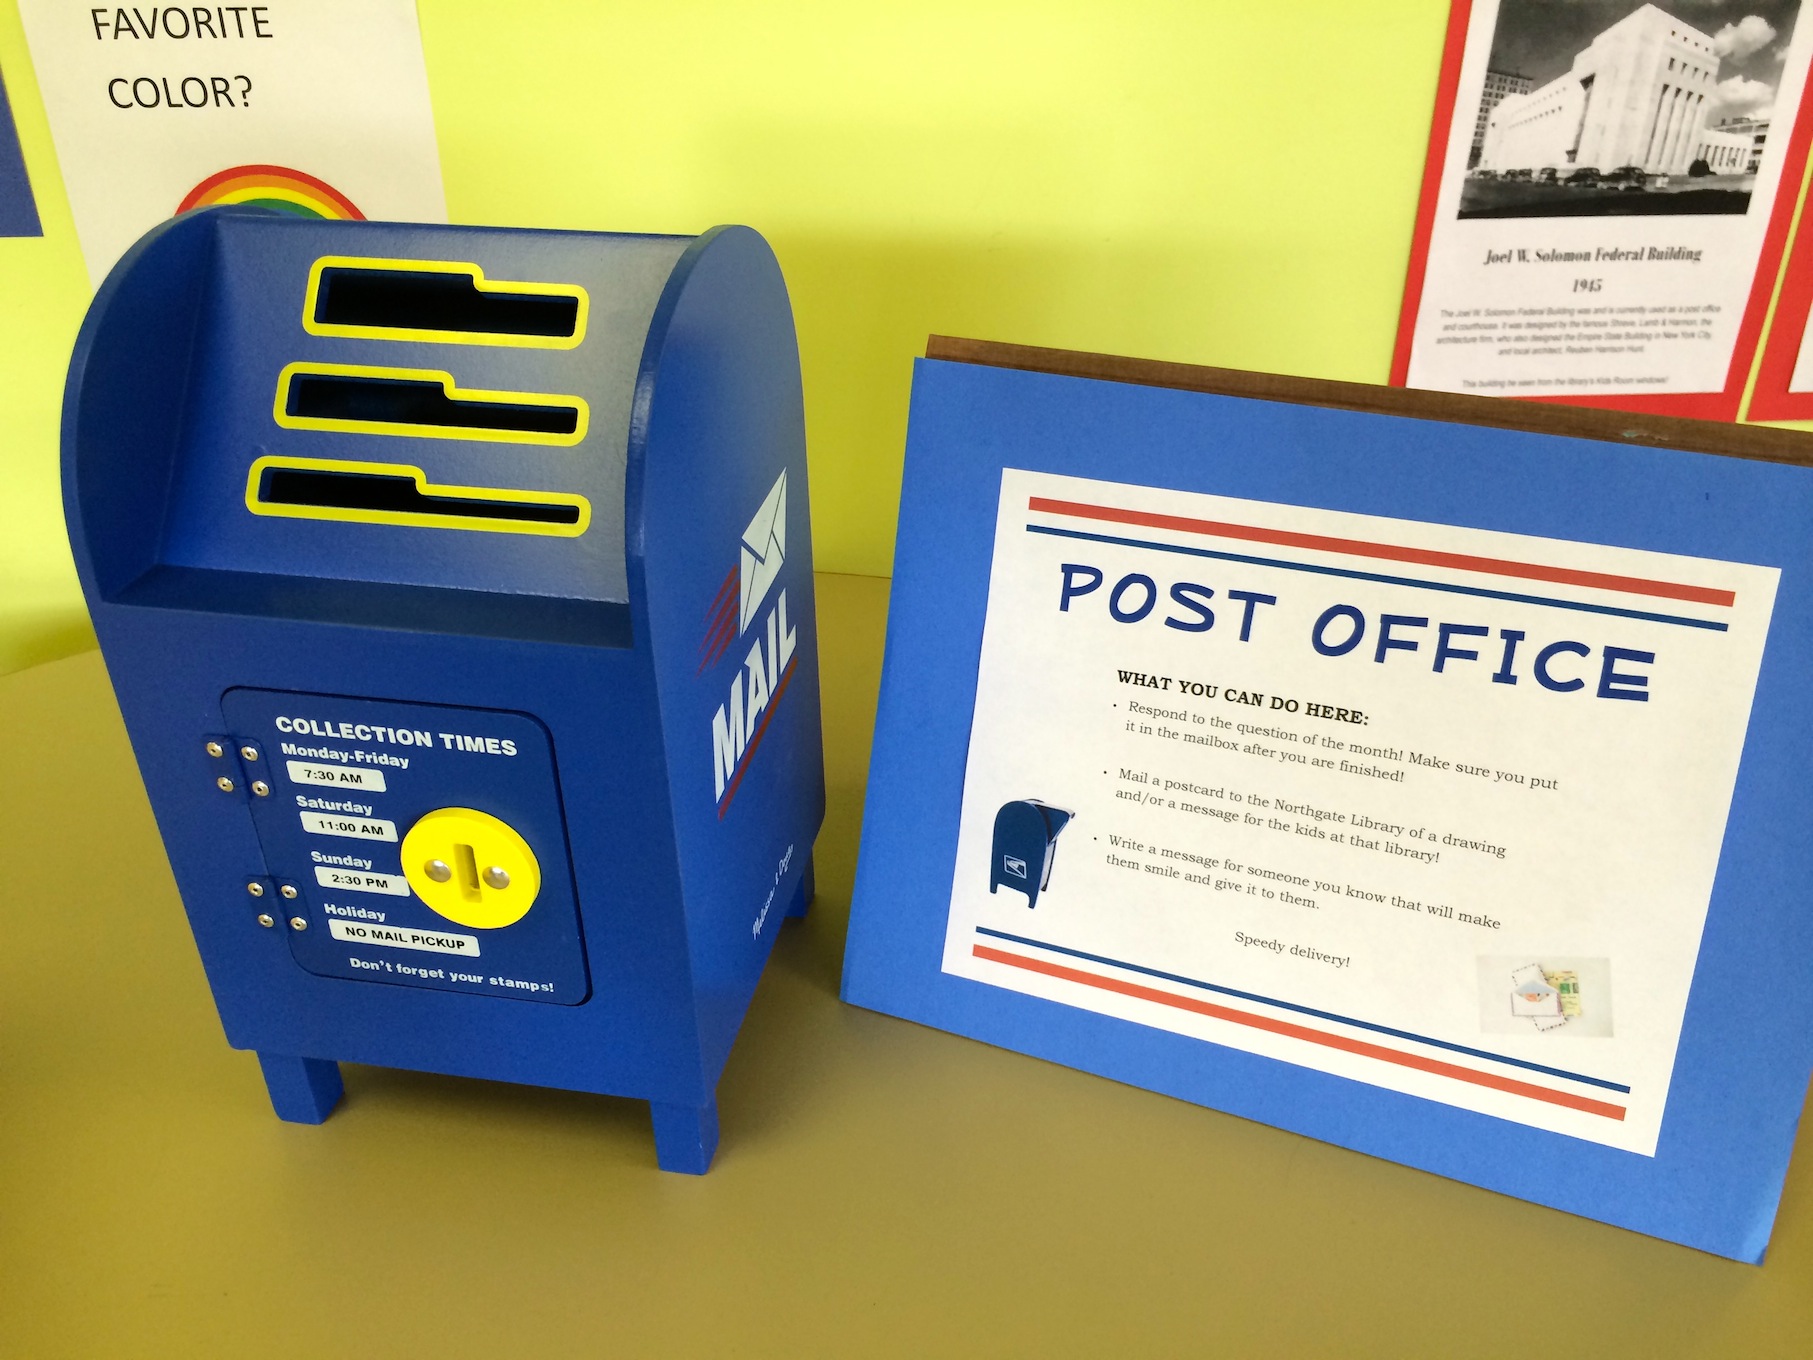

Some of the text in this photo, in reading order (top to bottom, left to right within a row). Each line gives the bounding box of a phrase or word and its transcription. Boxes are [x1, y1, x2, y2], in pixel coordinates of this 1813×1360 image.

[92, 7, 273, 40] FAVORITE
[109, 75, 251, 108] COLOR?
[1483, 246, 1702, 265] Joel W. Solomon Federal Building
[1573, 279, 1603, 292] 1945
[1059, 563, 1656, 702] POST OFFICE
[712, 588, 797, 804] MAIL
[1117, 669, 1369, 726] WHAT YOU CAN DO HERE:
[276, 716, 517, 756] COLLECTION TIMES
[1125, 719, 1405, 783] it in the mailbox after you are finished!
[1128, 700, 1559, 791] Respond to the question of the month! Make sure you put
[281, 743, 409, 769] Monday-Friday
[304, 770, 362, 783] 7:30 AM
[296, 795, 372, 816] Saturday
[1118, 767, 1507, 860] Mail a postcard to the Northgate Library of a drawing
[319, 821, 383, 835] 11:00 AM
[1115, 789, 1440, 865] and/or a message for the kids at that library!
[311, 851, 372, 870] Sunday
[332, 875, 387, 888] 2:30 PM
[1106, 853, 1320, 910] them smile and give it to them.
[1108, 834, 1501, 930] Write a message for someone you know that will make
[324, 903, 385, 922] Holiday
[346, 927, 464, 949] NO MAIL PICKUP
[1234, 931, 1350, 969] Speedy delivery!
[350, 958, 554, 992] Don't forget your stamps!
